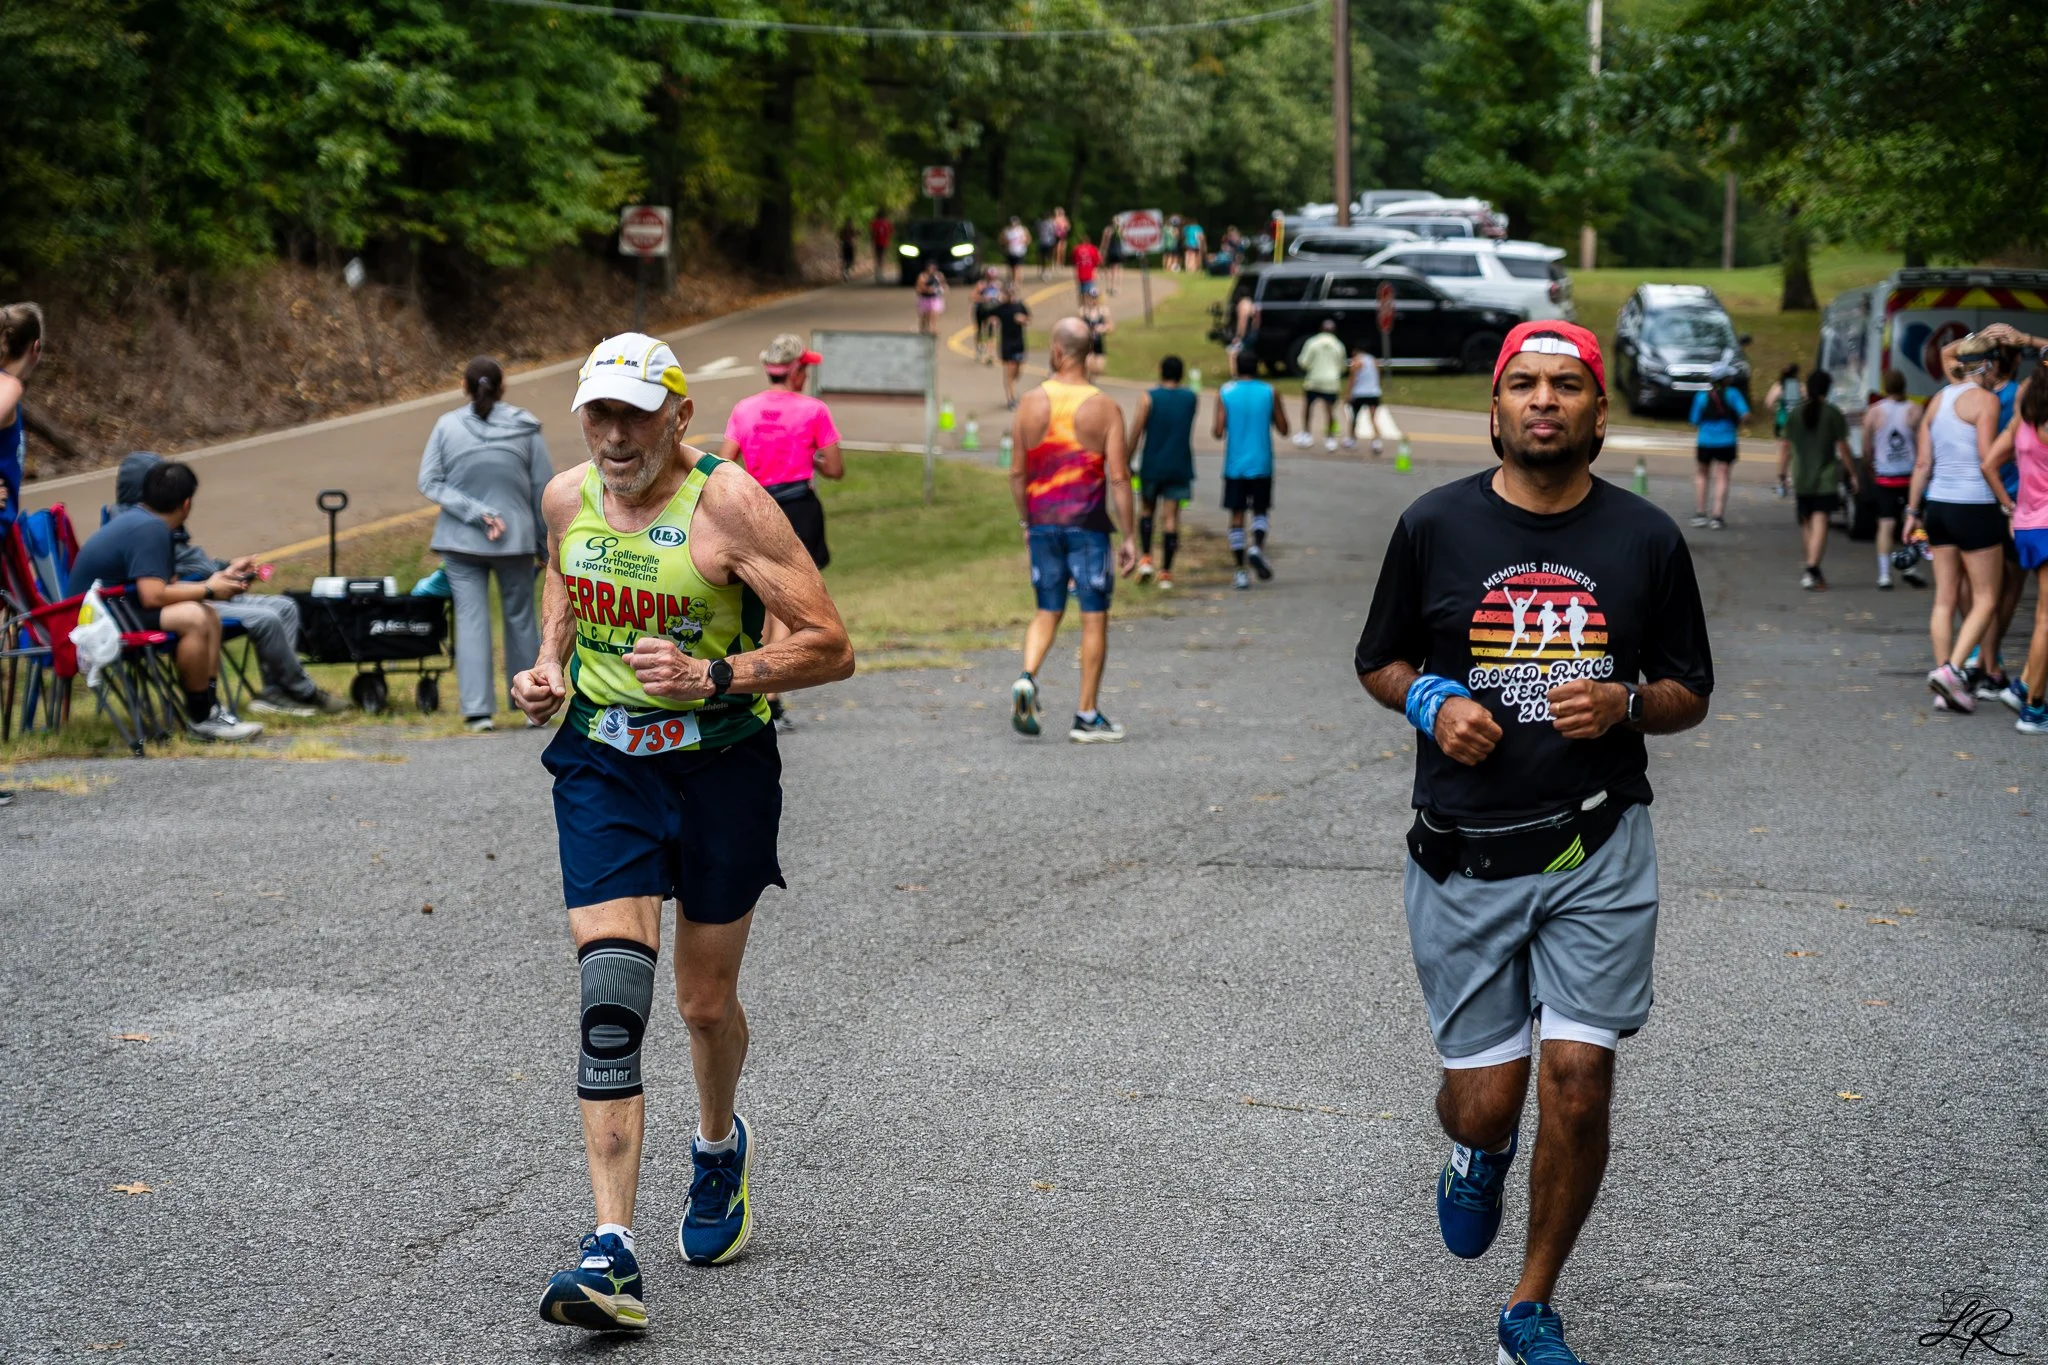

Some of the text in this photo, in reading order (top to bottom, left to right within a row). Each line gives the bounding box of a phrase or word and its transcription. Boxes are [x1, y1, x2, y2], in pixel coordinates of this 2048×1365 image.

[602, 557, 659, 574] orthopedics
[612, 550, 660, 566] collierville
[575, 560, 658, 583] & sports medicine
[1482, 562, 1597, 592] MEMPHIS RUNNERS
[563, 574, 690, 635] ERRAPIN
[578, 633, 626, 656] MEMP
[1469, 655, 1614, 690] ROAD RACE
[1501, 681, 1571, 706] SER
[1518, 700, 1557, 723] 20
[627, 719, 685, 753] 739
[585, 1067, 631, 1082] Mueller
